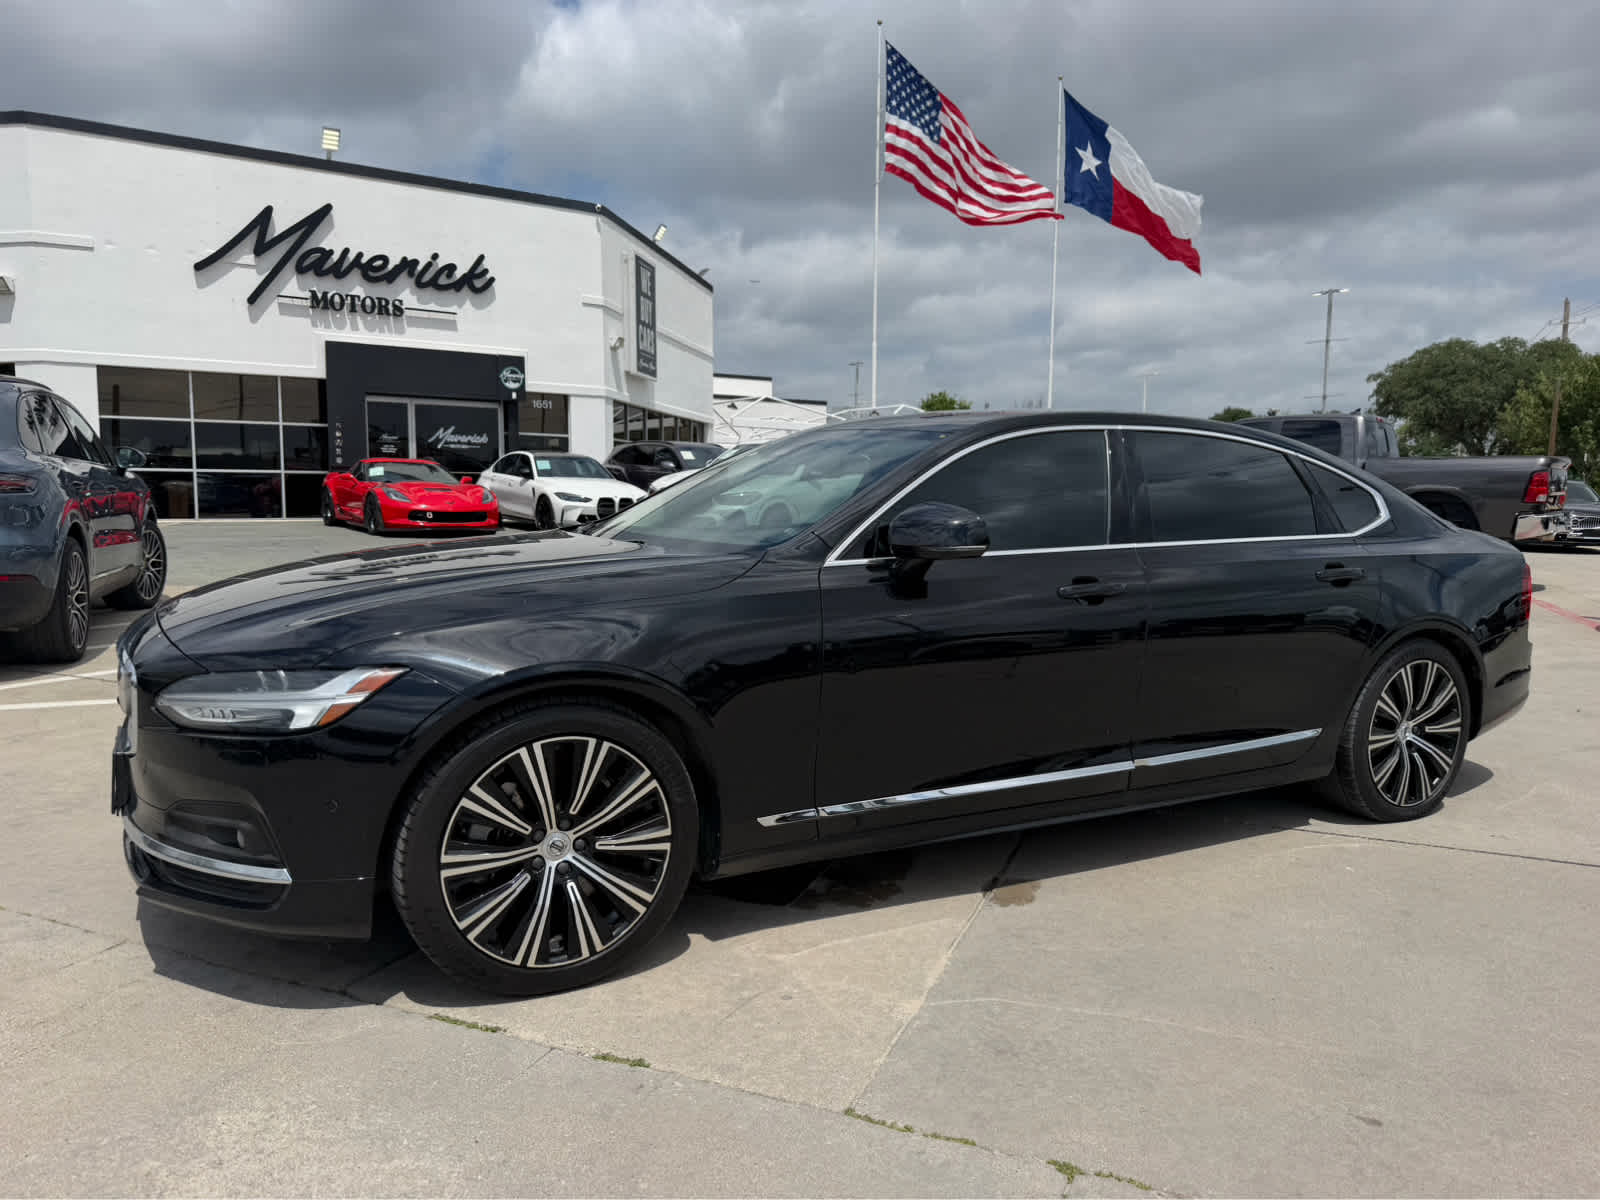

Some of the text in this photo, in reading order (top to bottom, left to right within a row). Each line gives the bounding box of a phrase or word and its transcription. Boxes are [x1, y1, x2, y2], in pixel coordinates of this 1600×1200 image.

[193, 202, 496, 305] Maverick
[308, 289, 405, 317] MOTORS
[532, 399, 552, 409] 1651
